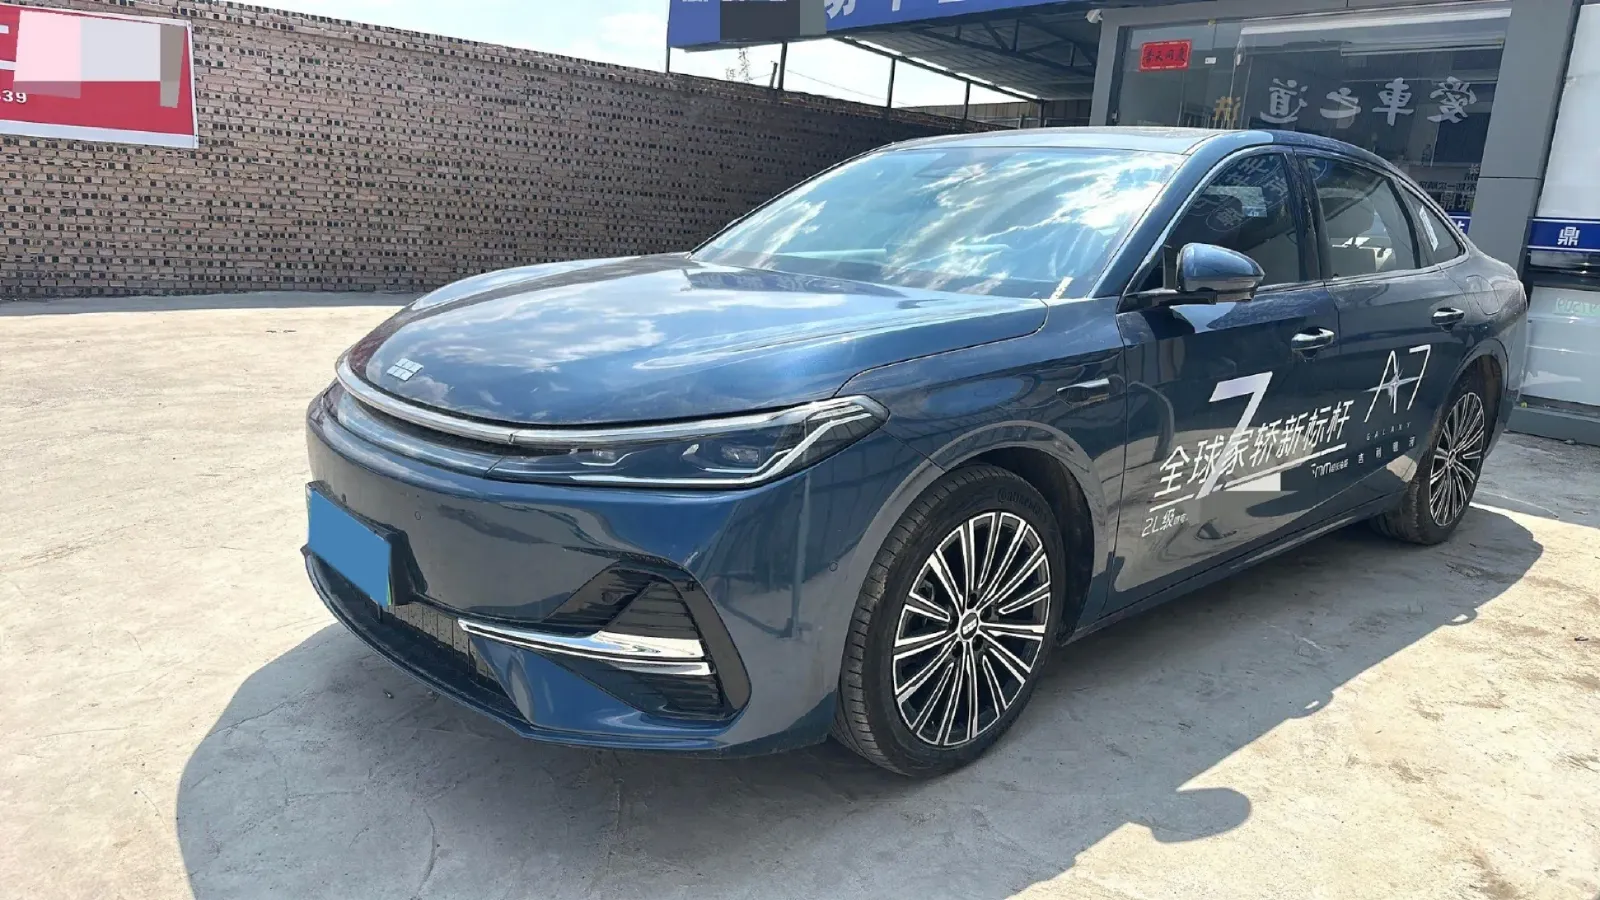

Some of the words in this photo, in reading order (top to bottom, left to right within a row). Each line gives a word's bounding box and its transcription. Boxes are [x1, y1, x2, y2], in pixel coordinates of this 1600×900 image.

[1557, 226, 1581, 246] 鼎
[1154, 399, 1355, 498] 全球家轿新标杆
[1195, 371, 1274, 500] 7
[1366, 422, 1412, 441] GALAXY
